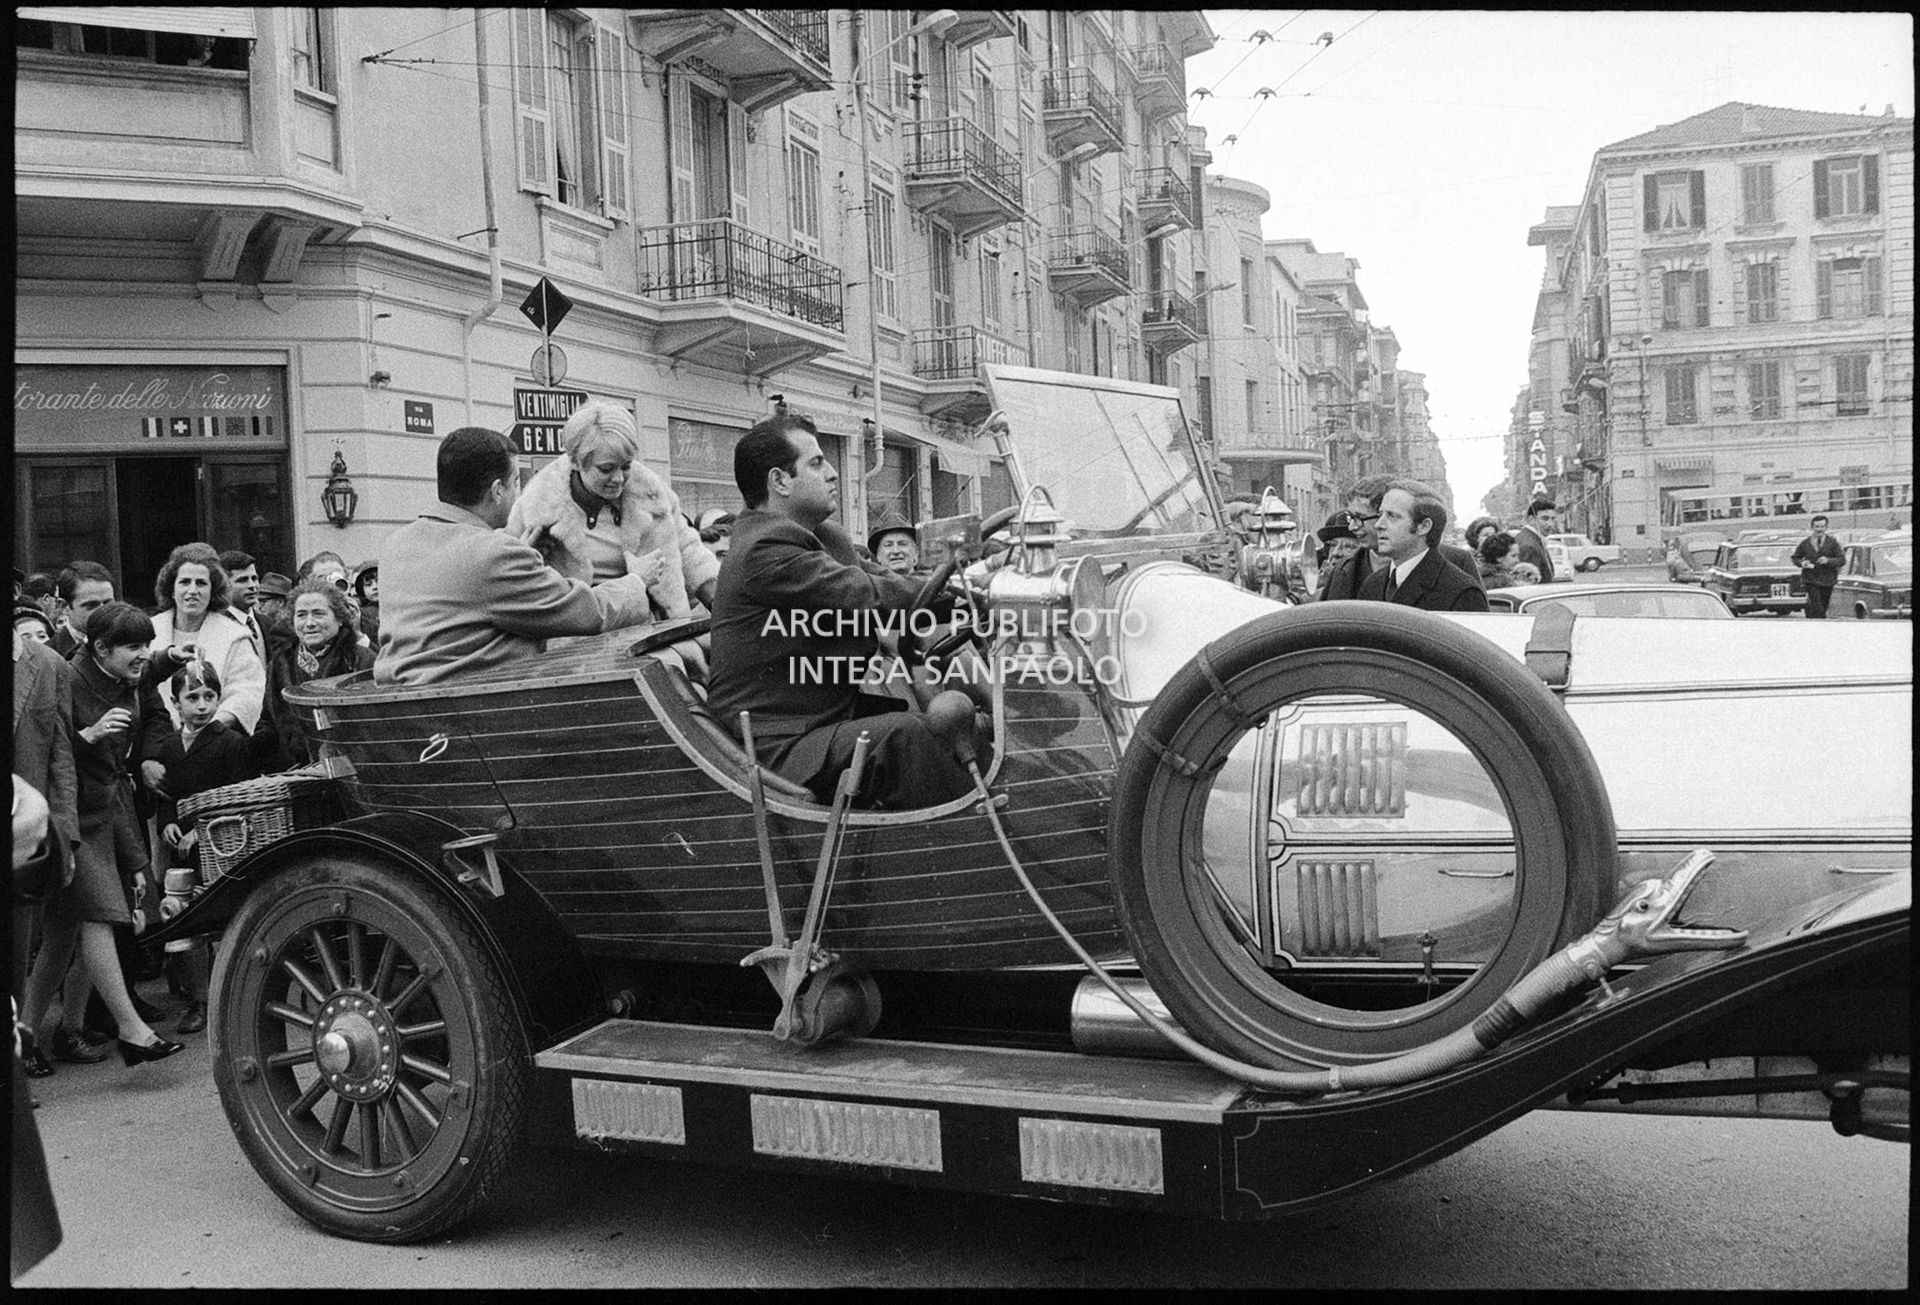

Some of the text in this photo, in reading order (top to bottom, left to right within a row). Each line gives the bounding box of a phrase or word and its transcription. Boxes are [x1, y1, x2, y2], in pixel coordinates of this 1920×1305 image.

[102, 379, 169, 409] delle
[407, 416, 433, 428] ROMA
[1528, 410, 1548, 495] STANDA
